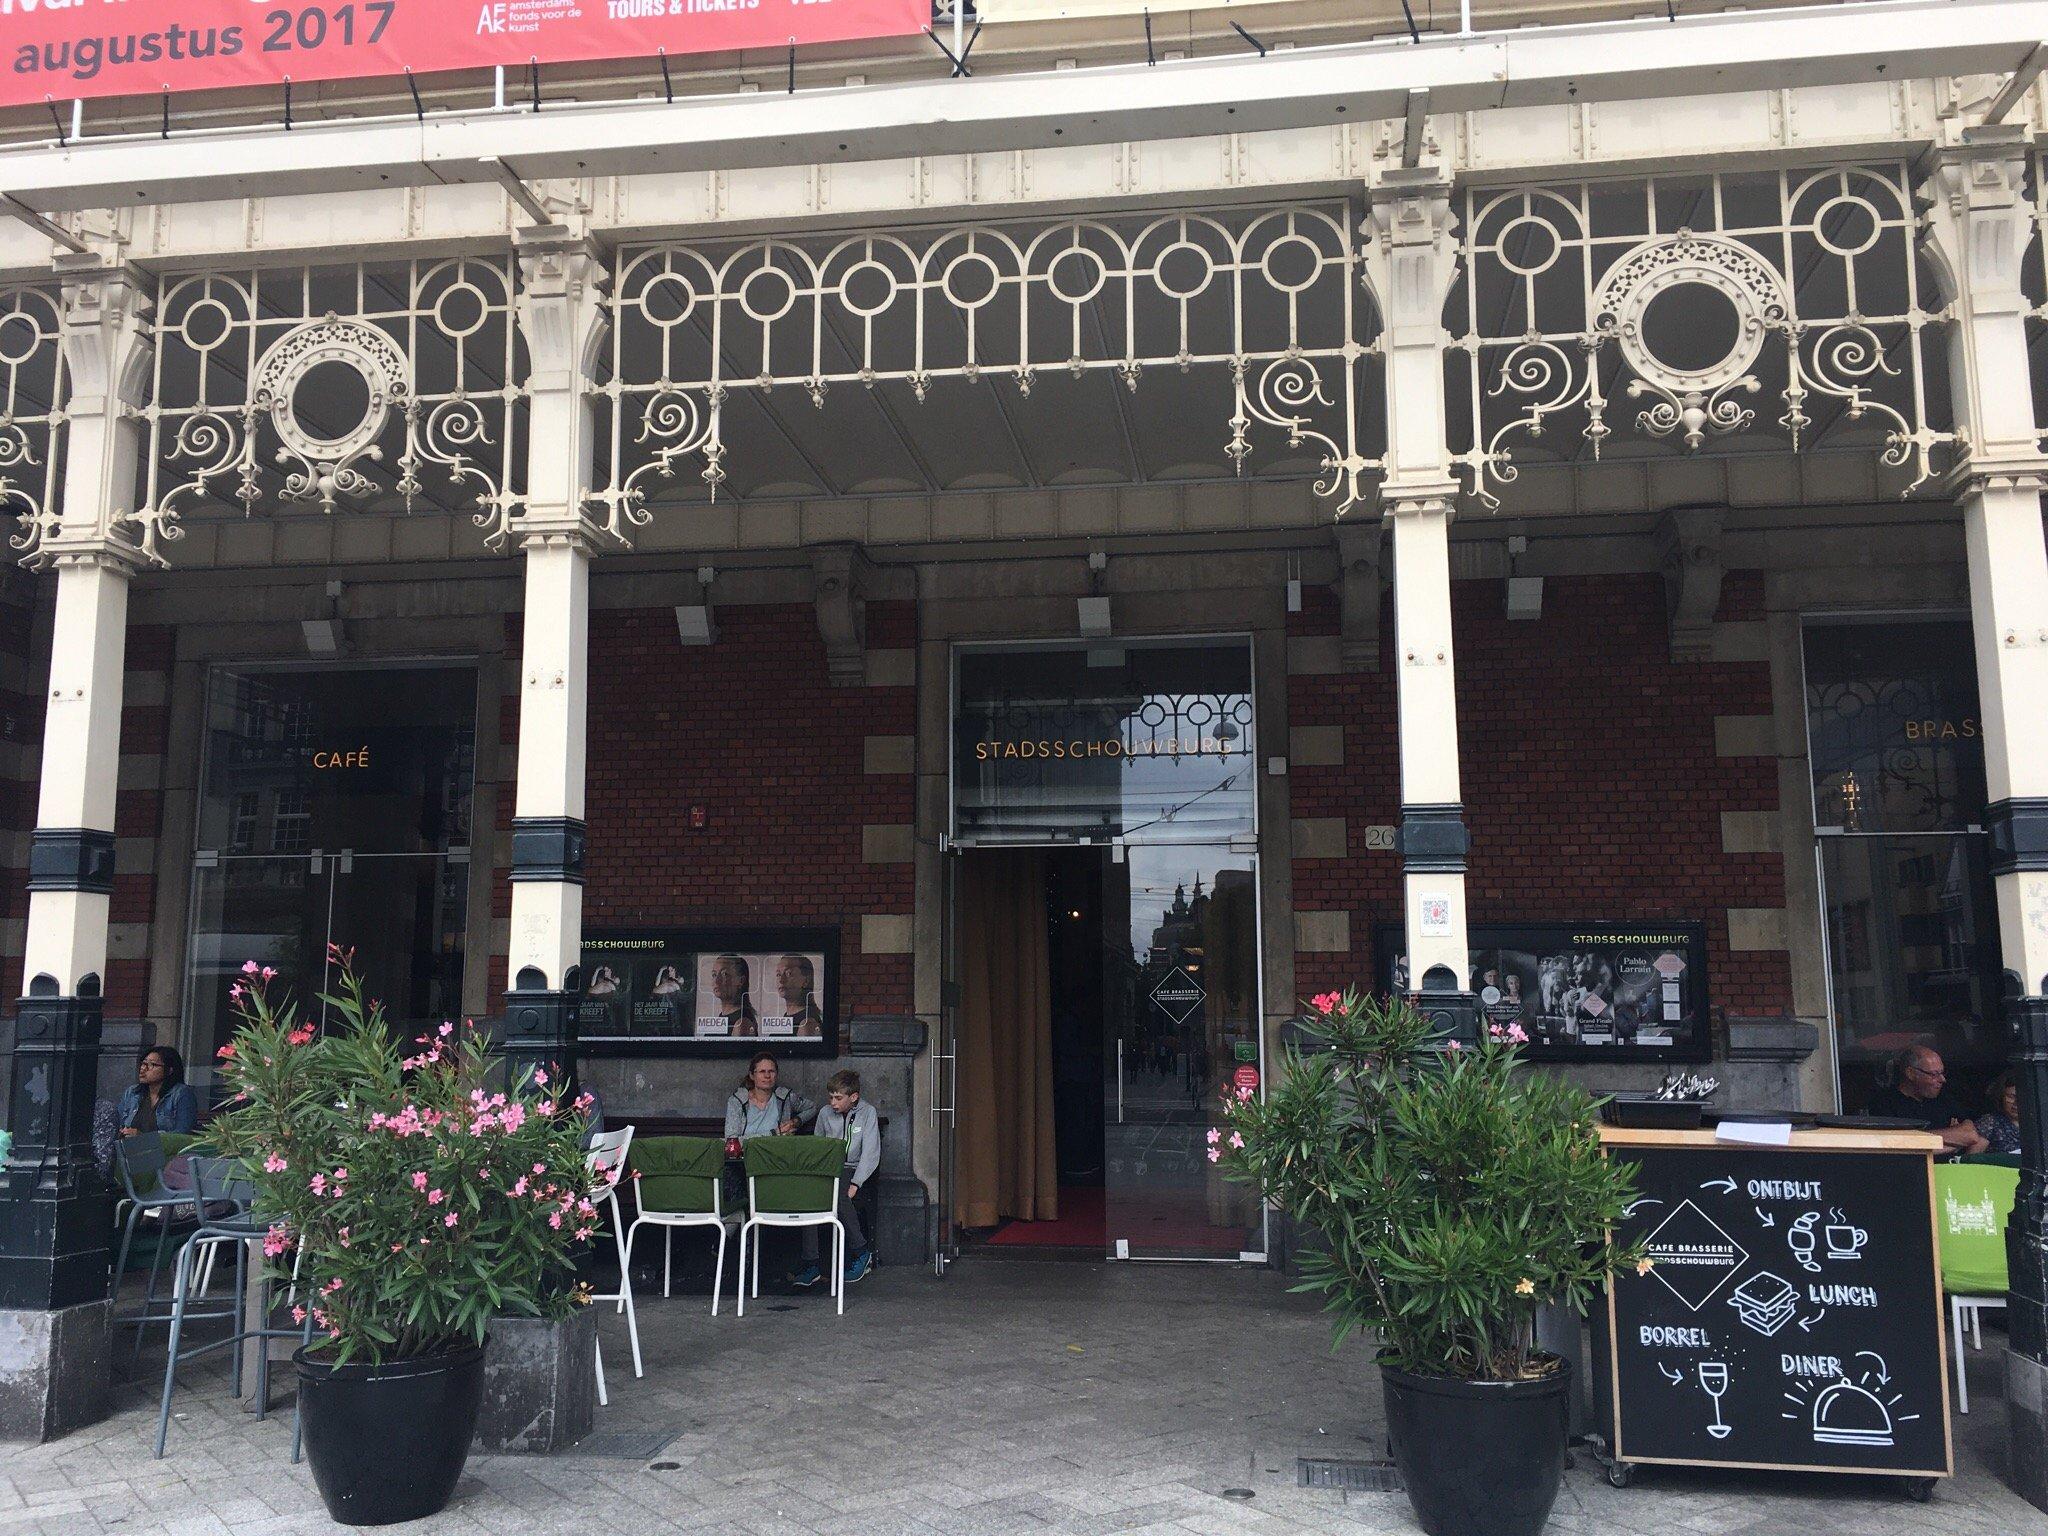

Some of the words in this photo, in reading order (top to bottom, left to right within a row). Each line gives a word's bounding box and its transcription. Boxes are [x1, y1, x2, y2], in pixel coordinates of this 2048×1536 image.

[509, 11, 541, 22] fonds
[541, 10, 566, 20] voor
[567, 8, 583, 18] de
[608, 0, 665, 19] TOURS
[508, 22, 540, 32] kunst
[13, 23, 243, 80] augustus
[263, 1, 396, 52] 2017
[1905, 718, 1982, 739] BRAS
[314, 745, 369, 768] CAFÉ
[975, 737, 1233, 760] STADSSCHOUWBURG
[1368, 828, 1395, 846] 26
[1623, 957, 1647, 965] Pablo
[699, 1018, 727, 1027] MEDEA
[763, 1018, 792, 1027] MEDEA
[1648, 1244, 1674, 1252] CAFE
[1678, 1244, 1734, 1253] BRASSERIE
[1809, 1284, 1877, 1307] LUNCH
[1640, 1326, 1711, 1347] BORREL
[1781, 1354, 1844, 1377] DINER
